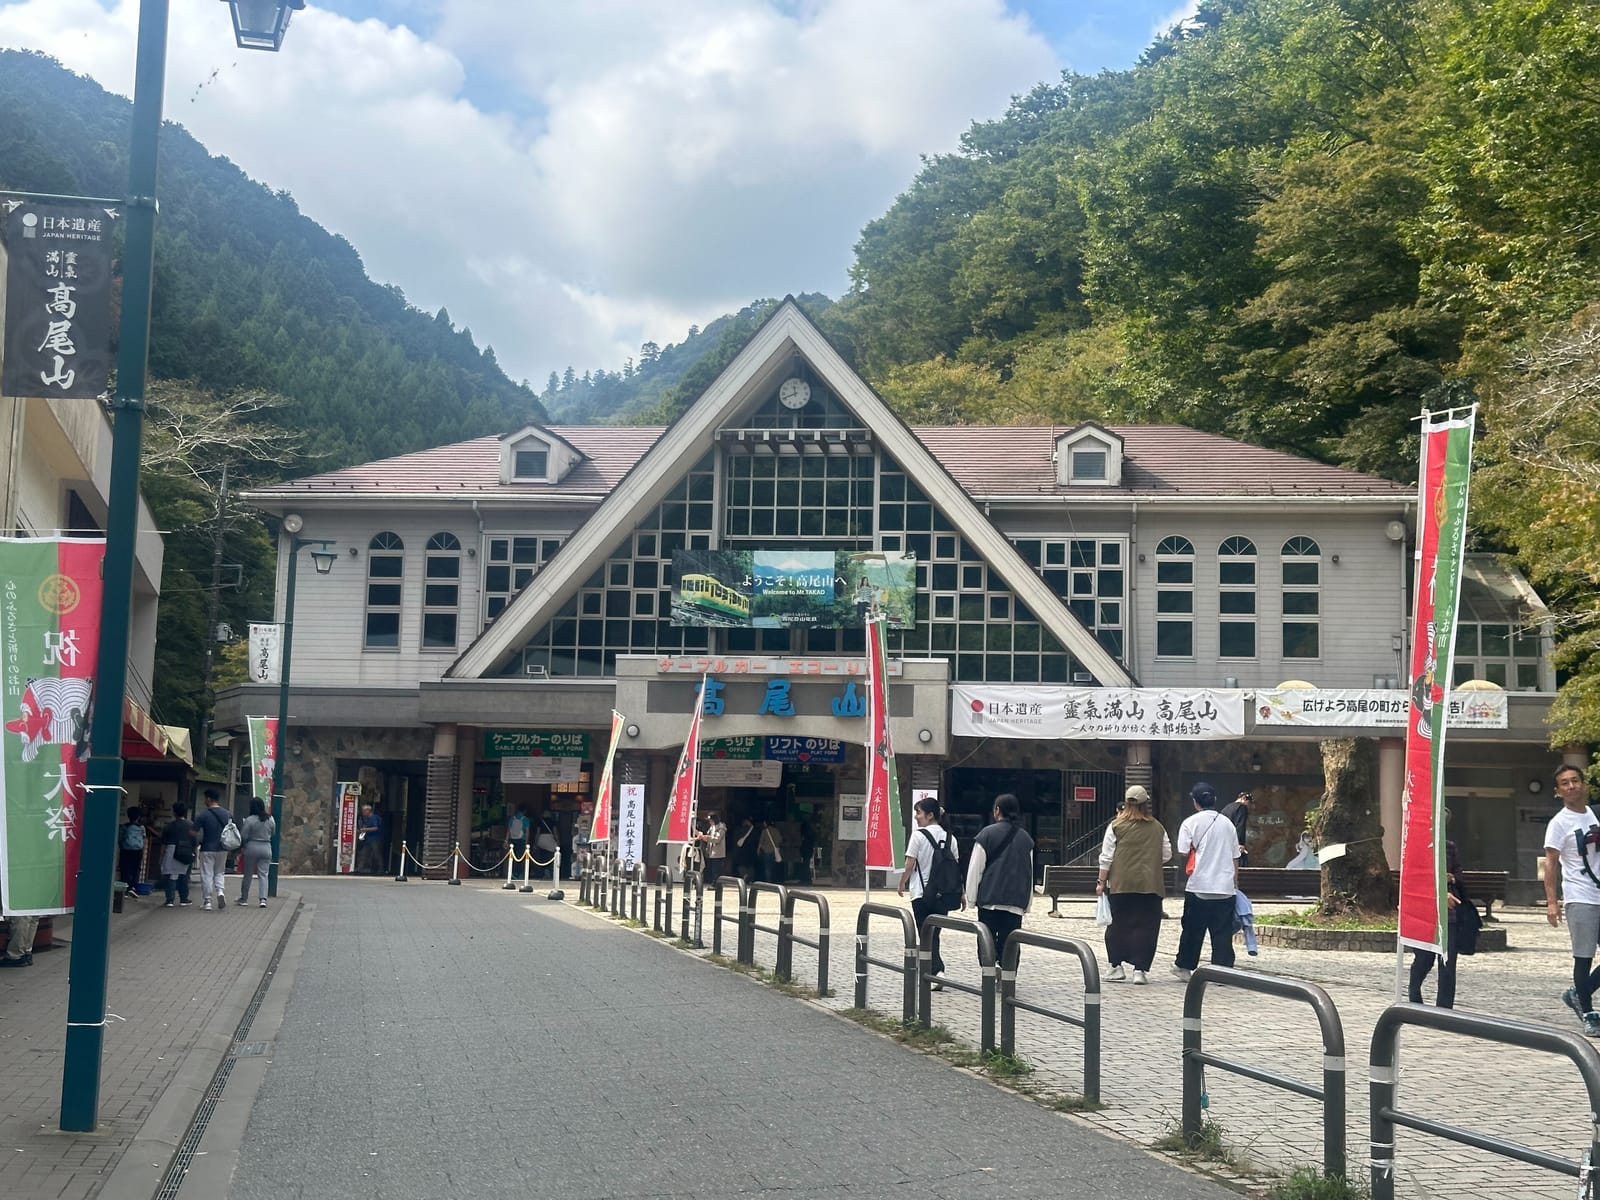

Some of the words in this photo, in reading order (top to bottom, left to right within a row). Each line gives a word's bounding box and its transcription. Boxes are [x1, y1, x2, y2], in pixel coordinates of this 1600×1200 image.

[43, 216, 102, 232] 日本遺産
[66, 233, 101, 241] HERITAGE
[989, 702, 1043, 715] 日本遺産
[493, 733, 583, 745] ケーブルカーのりば
[770, 738, 802, 749] リフト
[805, 738, 840, 750] のりば
[627, 786, 637, 797] 祝
[870, 786, 882, 839] 大本山高尾山
[625, 800, 637, 868] 高尾山秋季大祭
